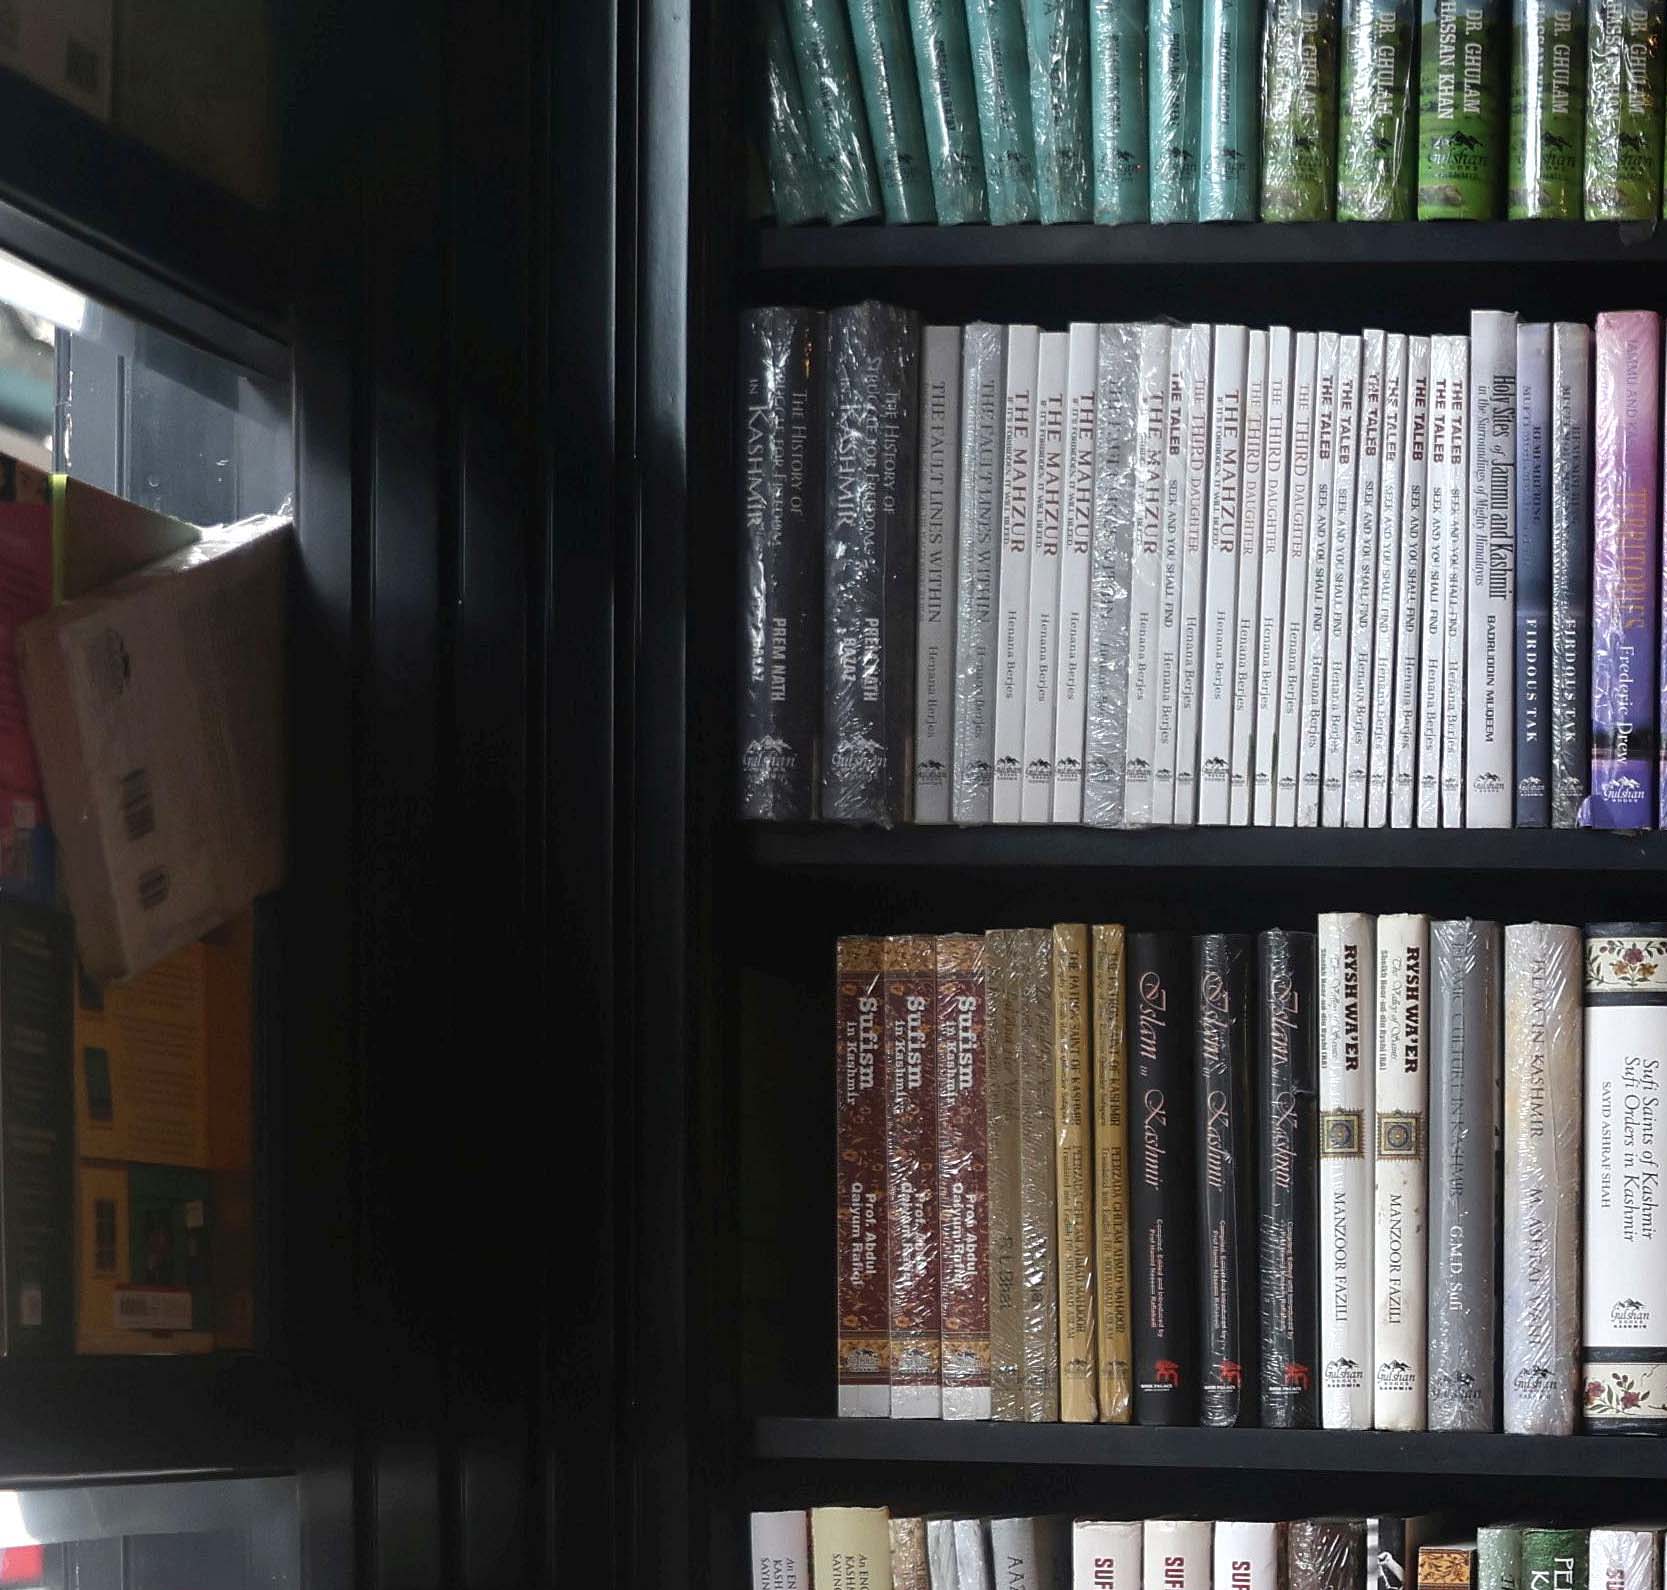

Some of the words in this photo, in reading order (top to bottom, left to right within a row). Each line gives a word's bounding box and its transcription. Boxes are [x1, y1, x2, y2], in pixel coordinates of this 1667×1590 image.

[927, 381, 945, 420] THE
[1046, 393, 1063, 442] THE
[928, 424, 946, 485] FAULT
[928, 489, 945, 545] LINES
[1044, 450, 1061, 556] MAHZUR
[927, 550, 944, 623] WITHIN
[927, 646, 939, 695] Henana
[1525, 619, 1538, 701] FIRDOUS
[925, 699, 938, 738] Berjes
[1526, 708, 1538, 743] TAK
[1406, 947, 1420, 1001] RYSH
[1388, 1194, 1403, 1274] MANZOOR
[1388, 1279, 1402, 1324] FAZILI
